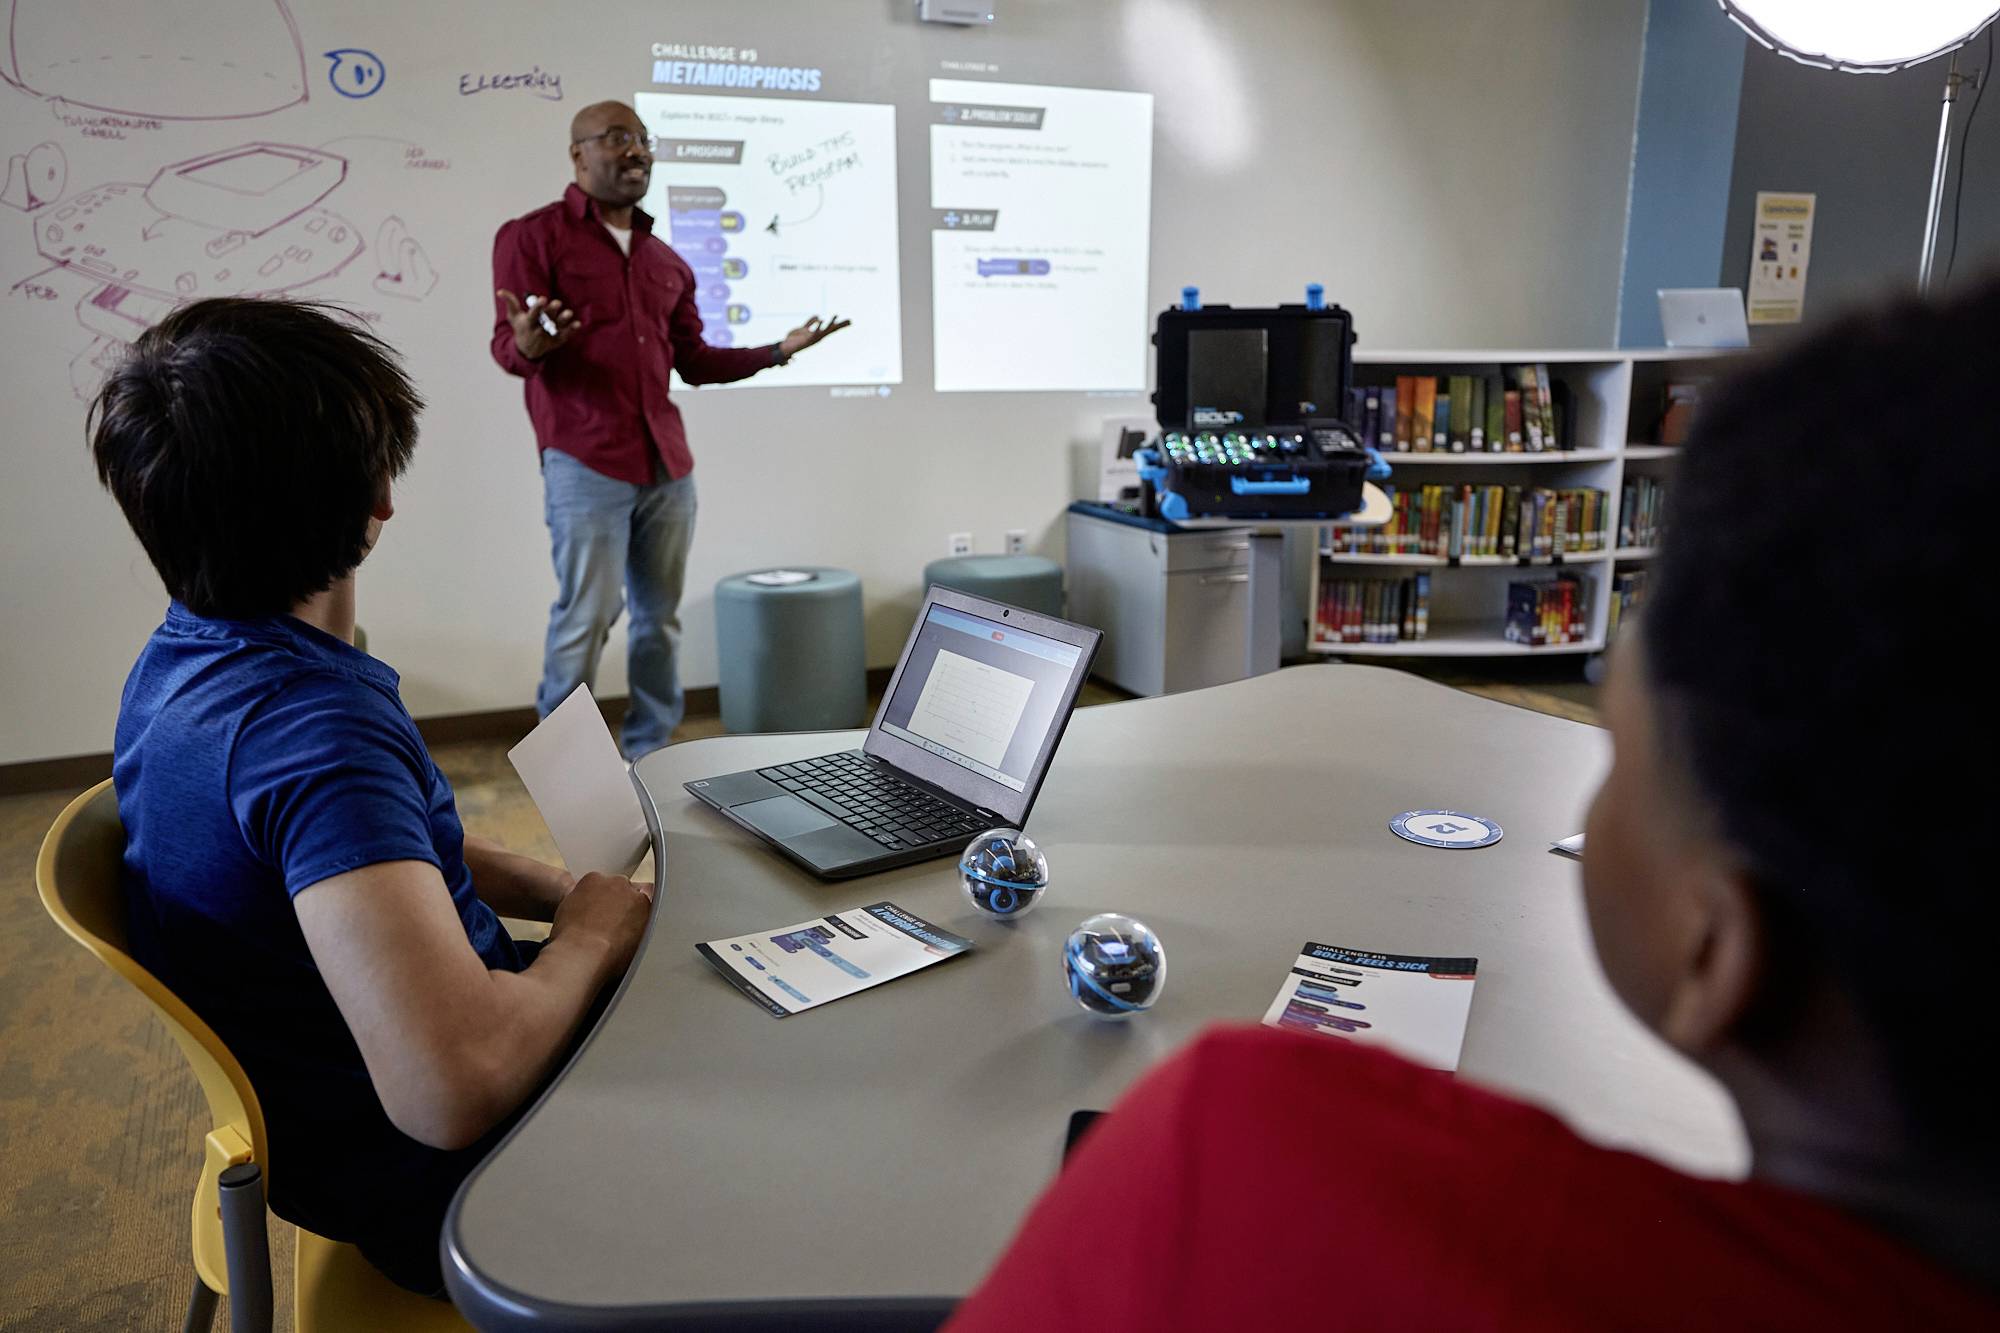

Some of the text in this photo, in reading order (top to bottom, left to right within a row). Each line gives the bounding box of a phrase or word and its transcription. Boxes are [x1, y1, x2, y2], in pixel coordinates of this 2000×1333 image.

[651, 43, 758, 62] CHALLENGE #9
[652, 60, 822, 91] METAMORPHOSIS
[25, 281, 59, 300] PCB
[1426, 822, 1470, 834] 12
[885, 905, 916, 923] CHALLENGE
[1312, 949, 1353, 961] BOLT+
[1354, 957, 1395, 968] FEELS
[1396, 961, 1430, 971] SICK
[1316, 945, 1368, 957] CHALLENGE
